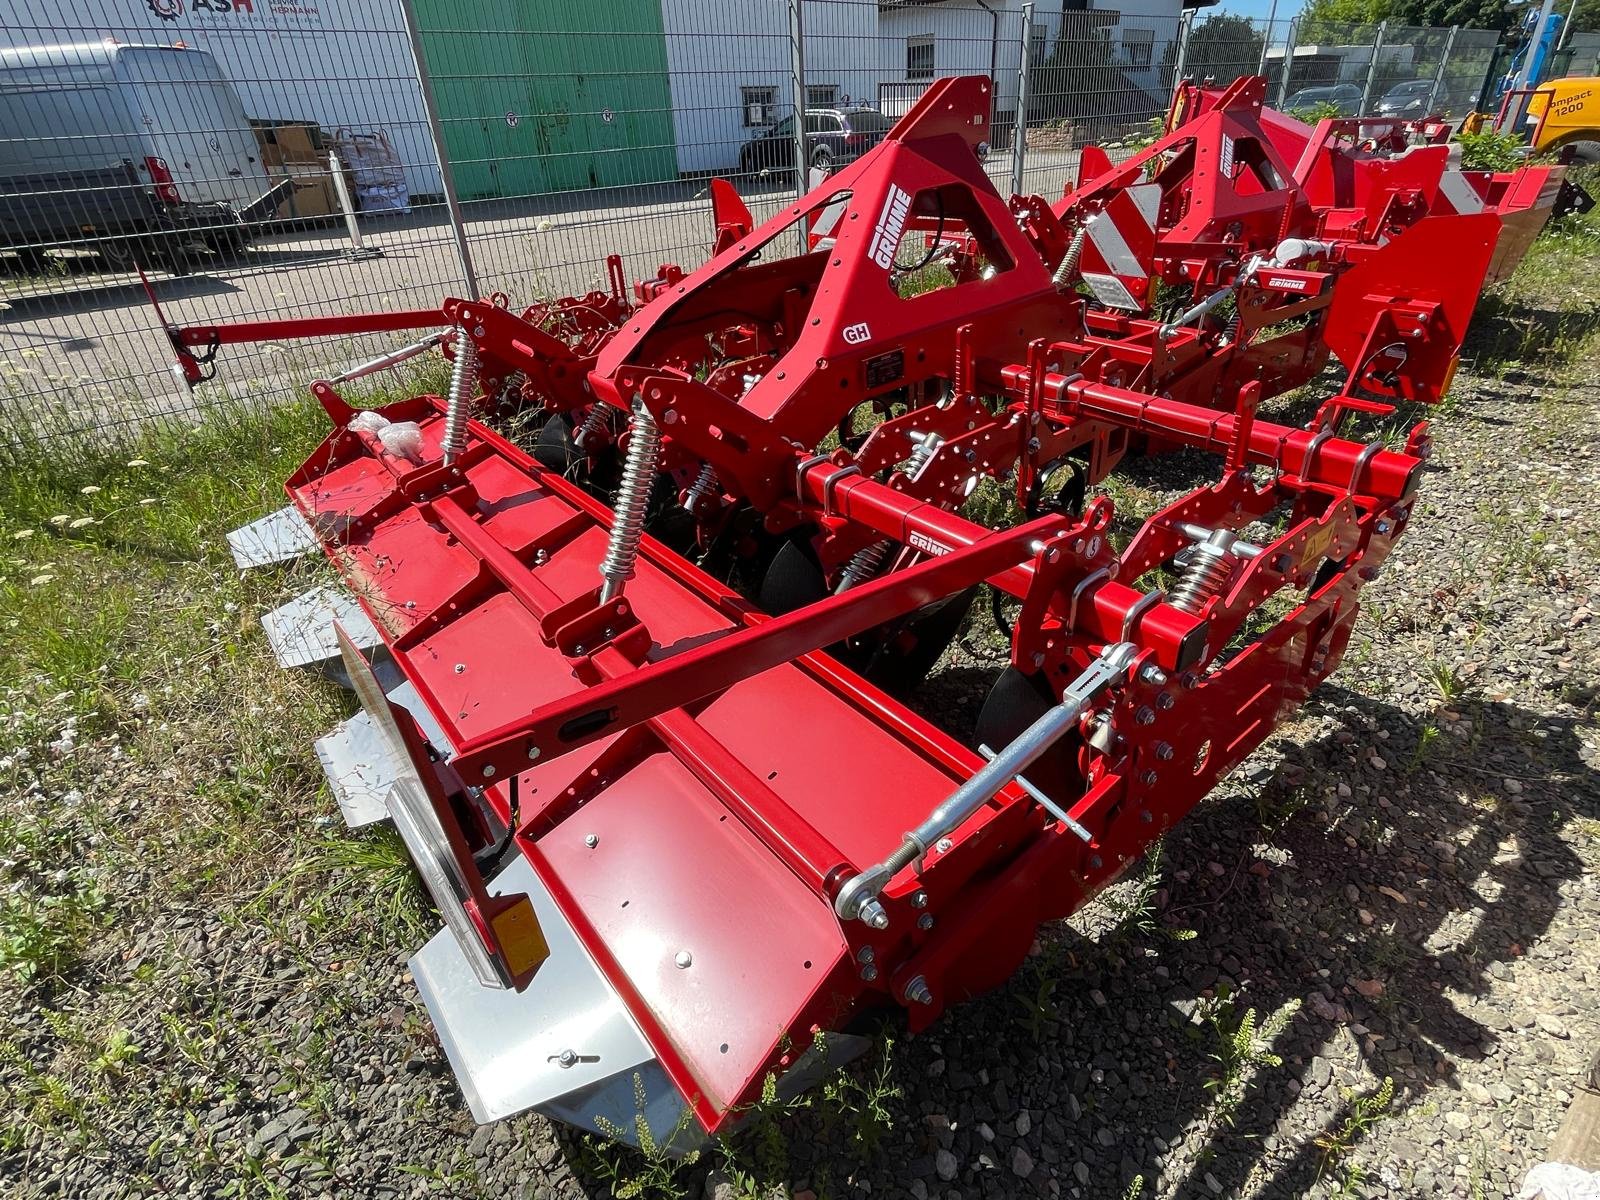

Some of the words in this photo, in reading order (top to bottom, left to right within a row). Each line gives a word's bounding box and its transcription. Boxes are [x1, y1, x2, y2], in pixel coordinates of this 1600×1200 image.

[192, 0, 254, 13] ASH
[271, 7, 319, 15] HERMANN
[1551, 90, 1593, 108] ompact
[1555, 102, 1584, 117] 1200
[1220, 133, 1234, 179] GRIMME
[868, 183, 912, 270] GRIMME
[1269, 277, 1307, 290] GRIMME
[845, 325, 869, 342] GH
[910, 530, 955, 557] GRIM
